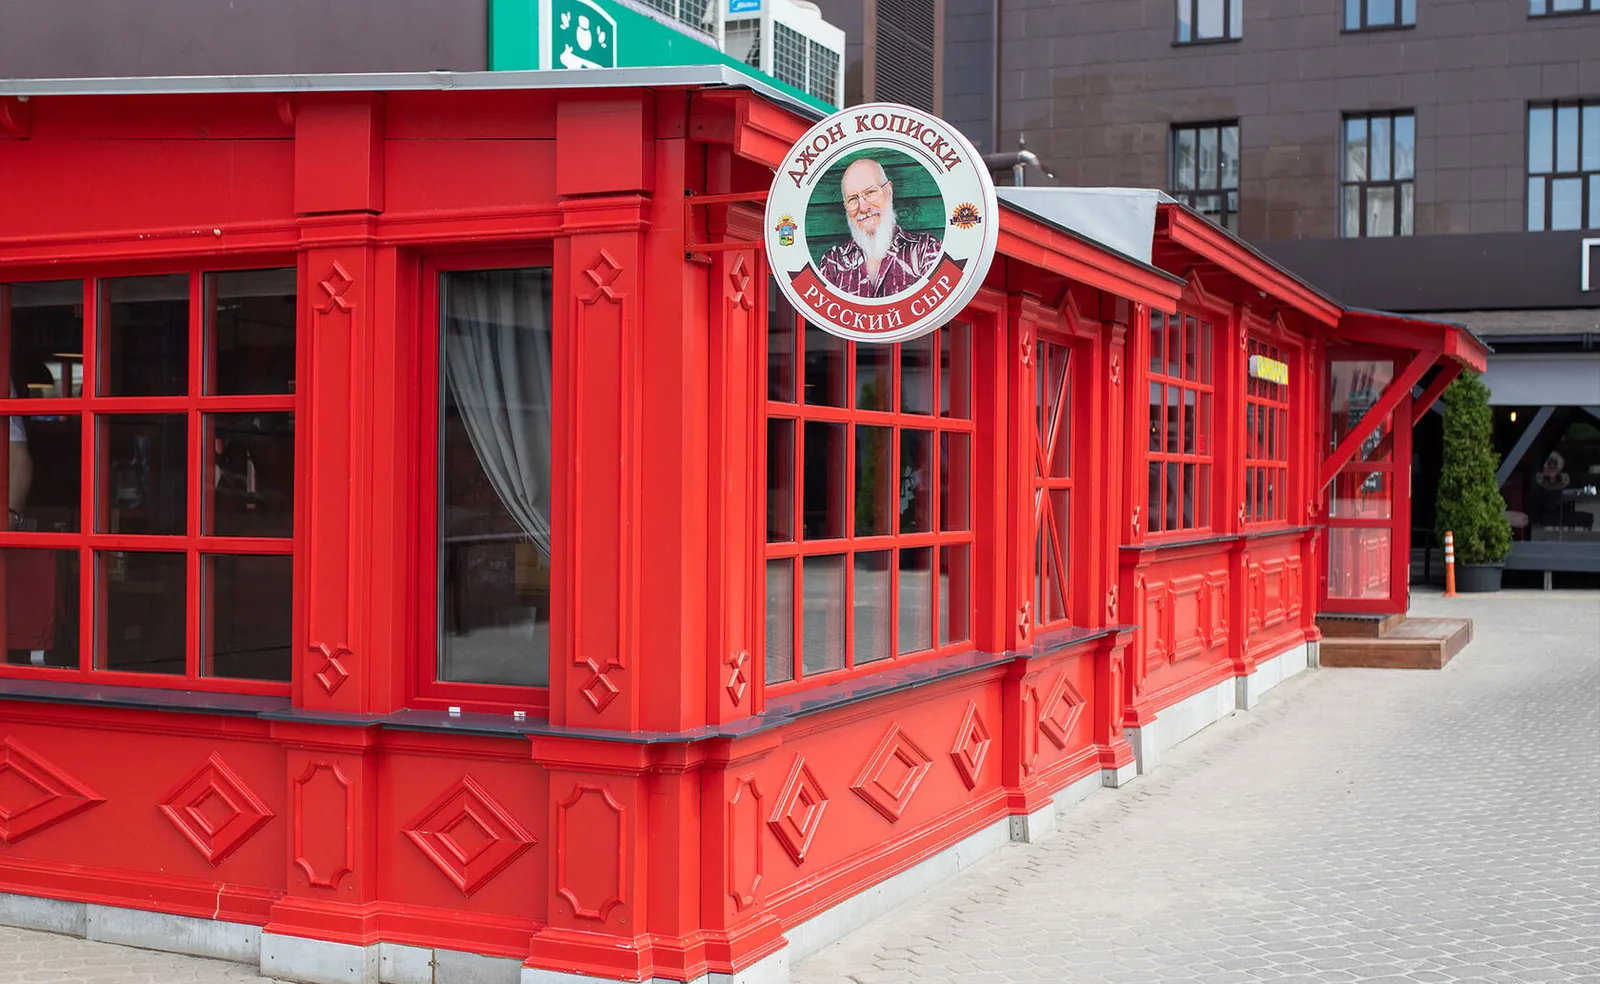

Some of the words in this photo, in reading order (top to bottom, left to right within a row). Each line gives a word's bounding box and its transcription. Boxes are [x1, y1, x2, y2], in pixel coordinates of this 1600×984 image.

[788, 122, 847, 189] ДЖОН
[855, 113, 962, 172] КОПИСКИ
[802, 283, 904, 331] РУССКИЙ
[910, 274, 953, 316] СЫР
